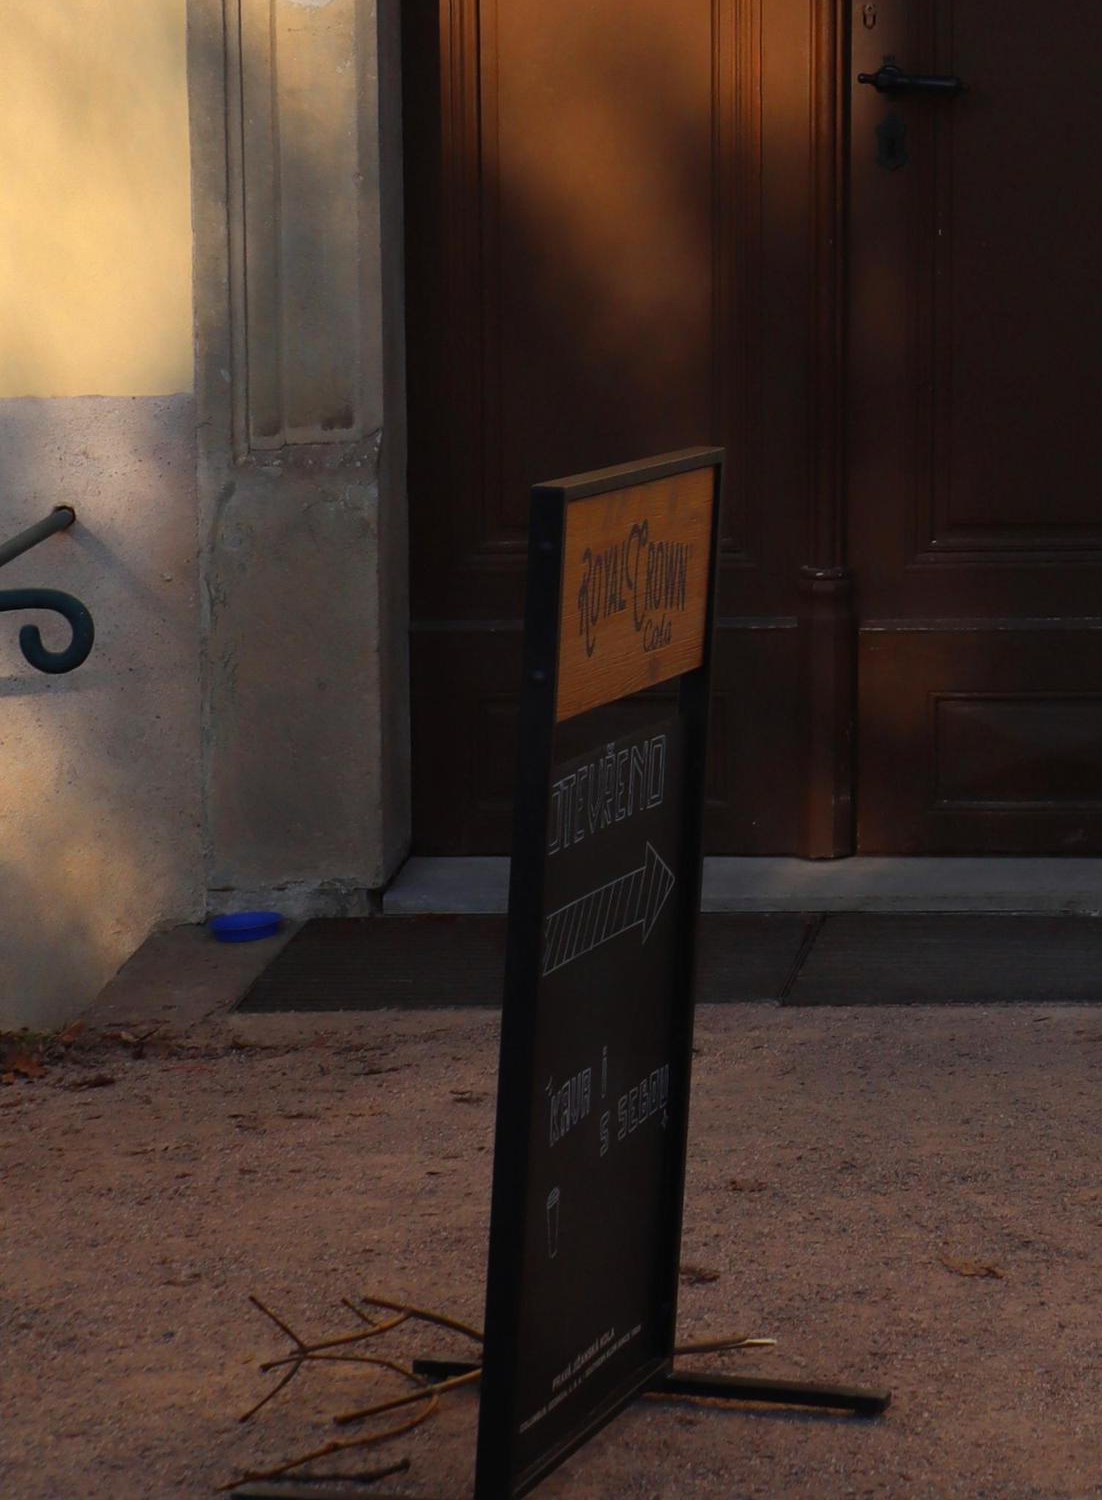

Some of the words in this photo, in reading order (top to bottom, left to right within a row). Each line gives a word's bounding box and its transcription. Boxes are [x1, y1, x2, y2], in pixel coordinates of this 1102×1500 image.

[577, 538, 627, 658] ROYAL
[625, 518, 689, 632] CROWN
[642, 612, 673, 652] Cola
